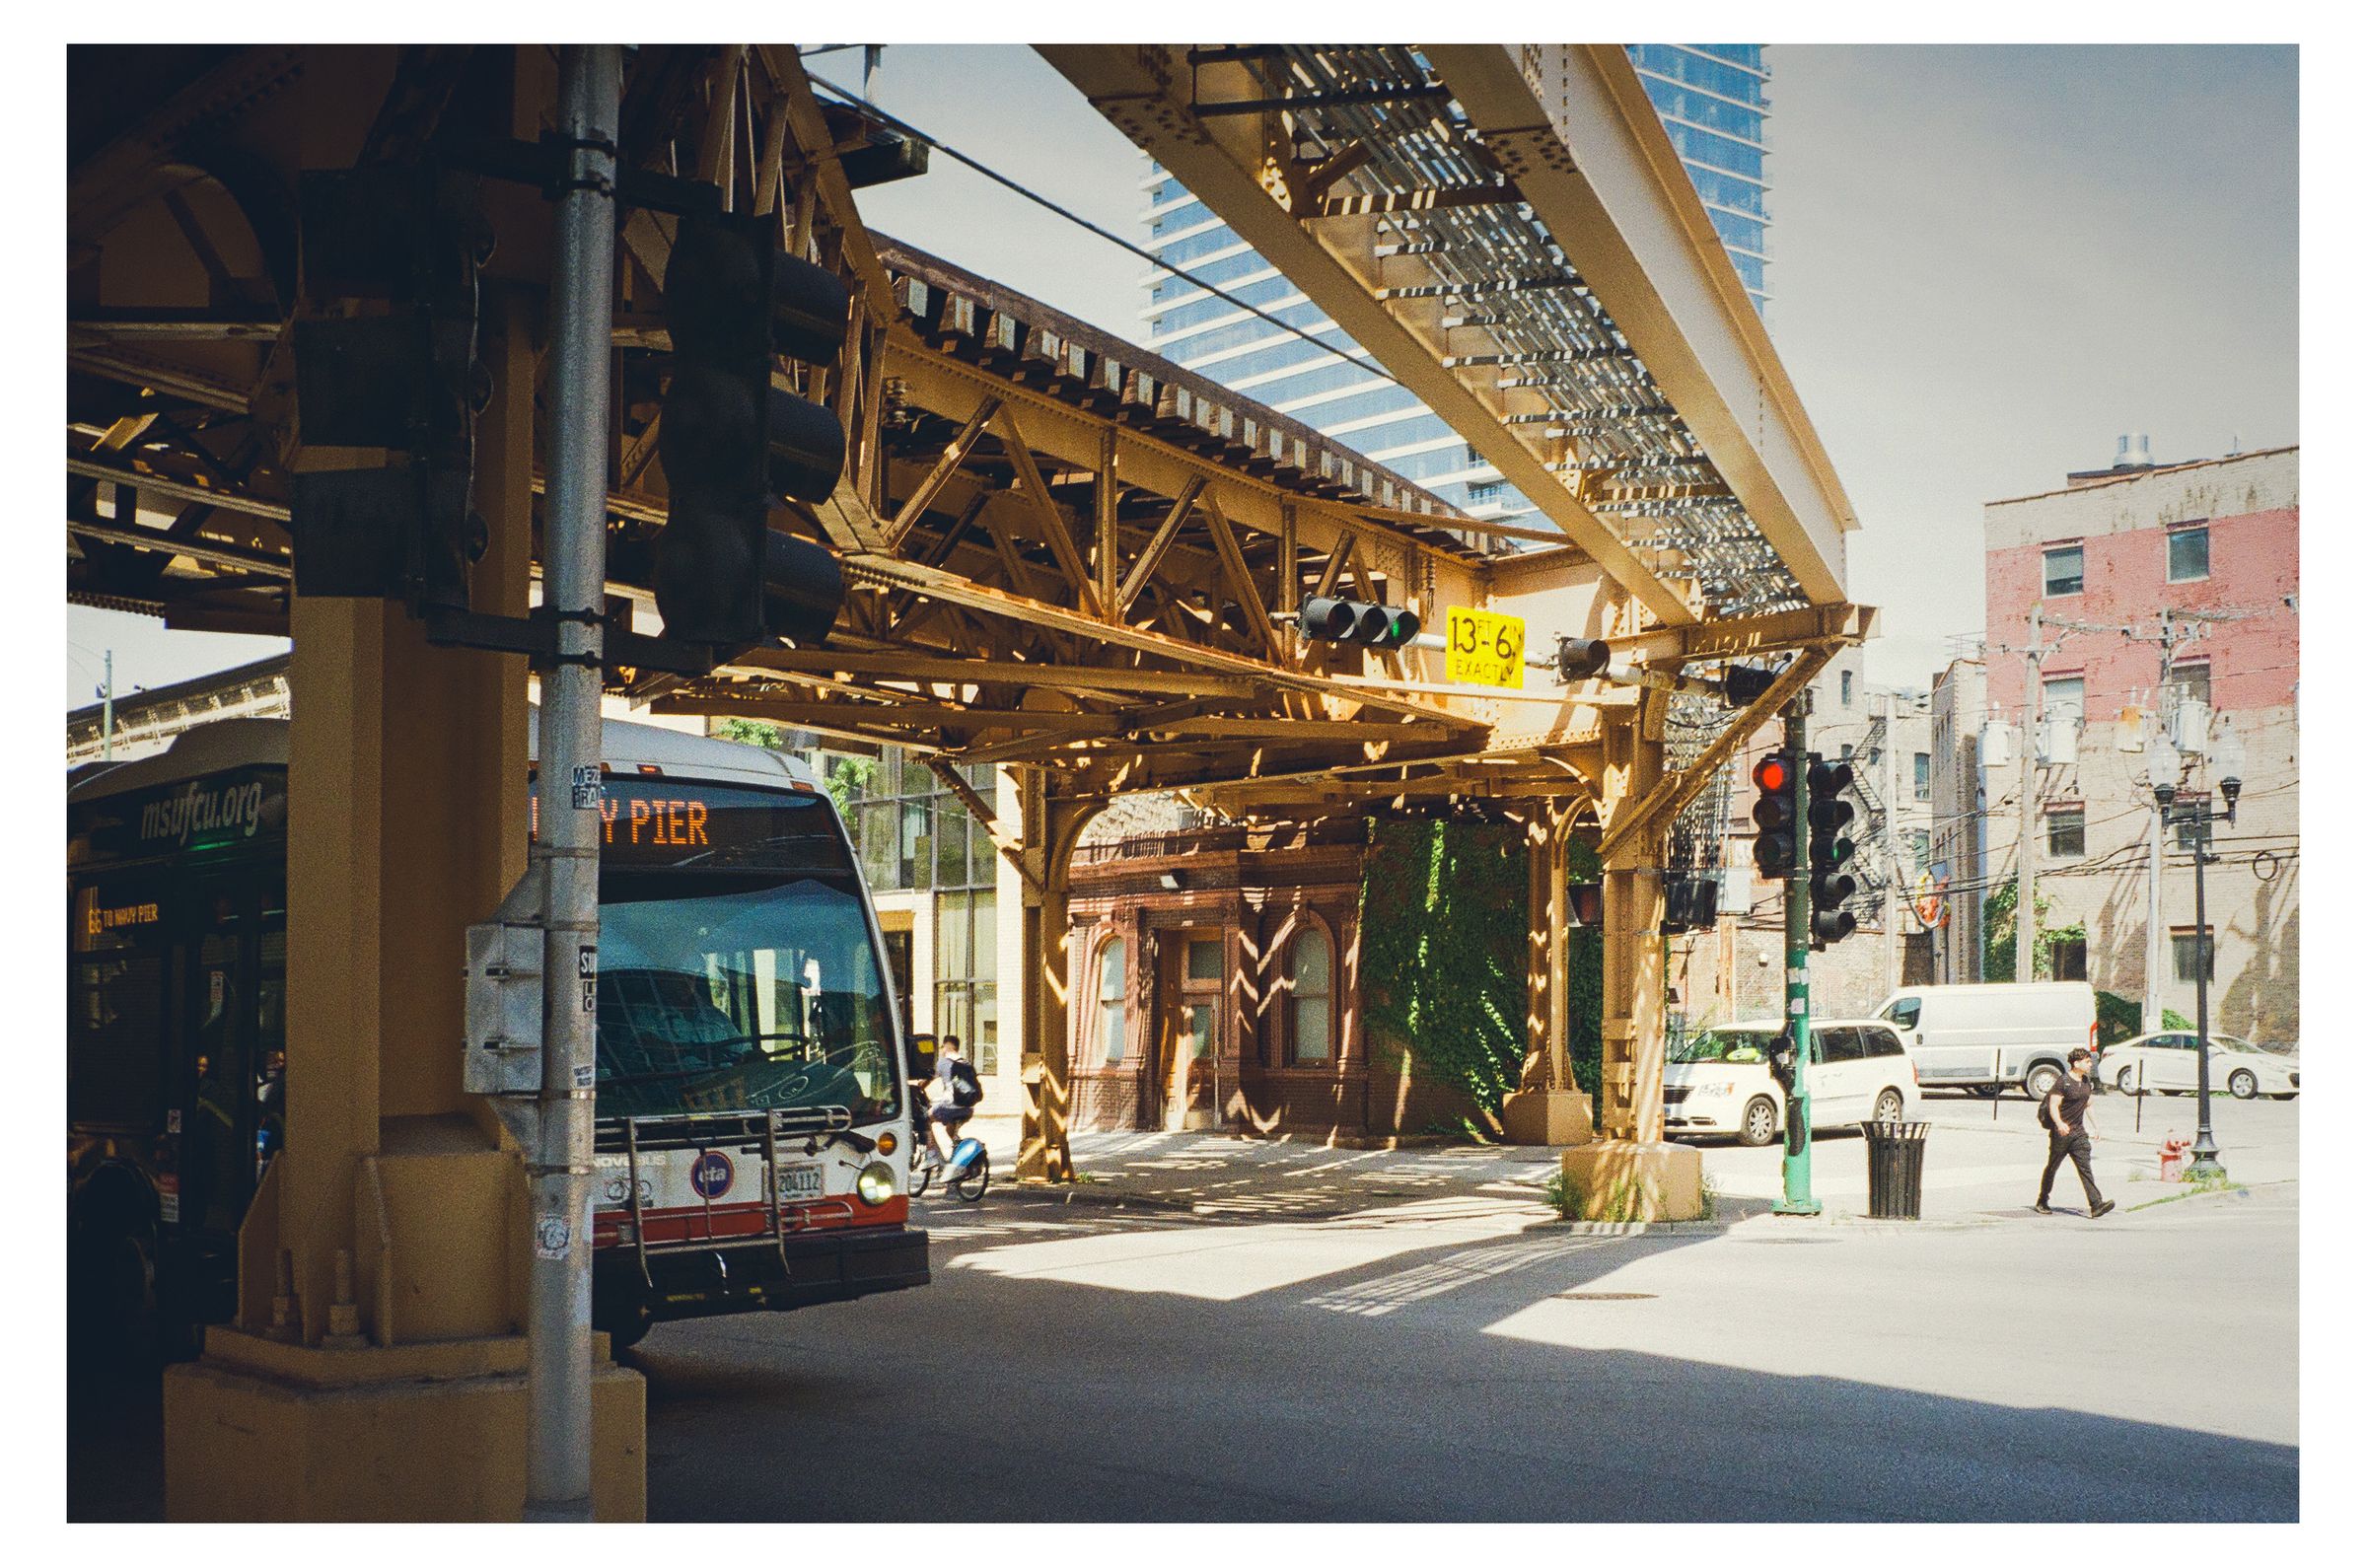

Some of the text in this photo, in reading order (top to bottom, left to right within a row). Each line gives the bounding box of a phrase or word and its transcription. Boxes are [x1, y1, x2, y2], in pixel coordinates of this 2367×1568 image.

[1456, 659, 1515, 682] EXACTLY
[141, 781, 262, 847] msufcu.org
[631, 799, 709, 845] PIER
[88, 909, 103, 934] 66
[104, 909, 113, 927] TO
[138, 903, 159, 923] PIER
